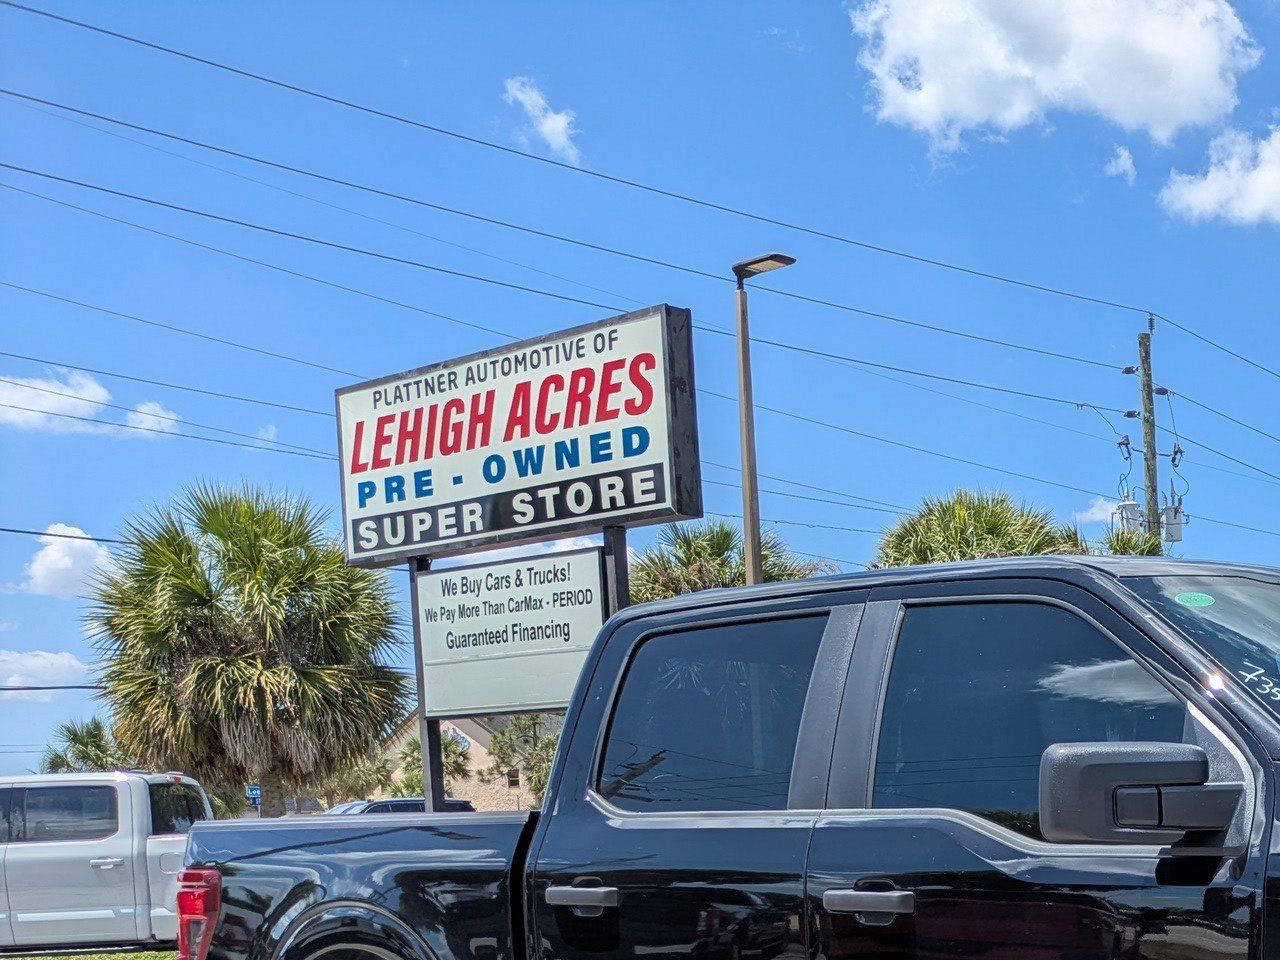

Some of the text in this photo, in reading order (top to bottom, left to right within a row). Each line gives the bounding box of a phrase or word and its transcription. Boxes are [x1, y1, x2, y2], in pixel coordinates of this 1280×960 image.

[373, 329, 620, 410] PLATTNER AUTOMOTIVE OF
[350, 352, 656, 475] LEHIGH ACRES
[357, 469, 433, 509] PRE
[482, 425, 650, 484] OWNED
[358, 469, 657, 550] SUPER STORE
[425, 608, 438, 623] We
[440, 606, 456, 624] Pay
[458, 604, 480, 618] More
[482, 600, 505, 616] Than
[508, 595, 544, 613] CarMax
[552, 588, 593, 609] PERIOD
[441, 562, 571, 598] We Buy Cars & Trucks!
[446, 619, 571, 650] Guaranteed Financing
